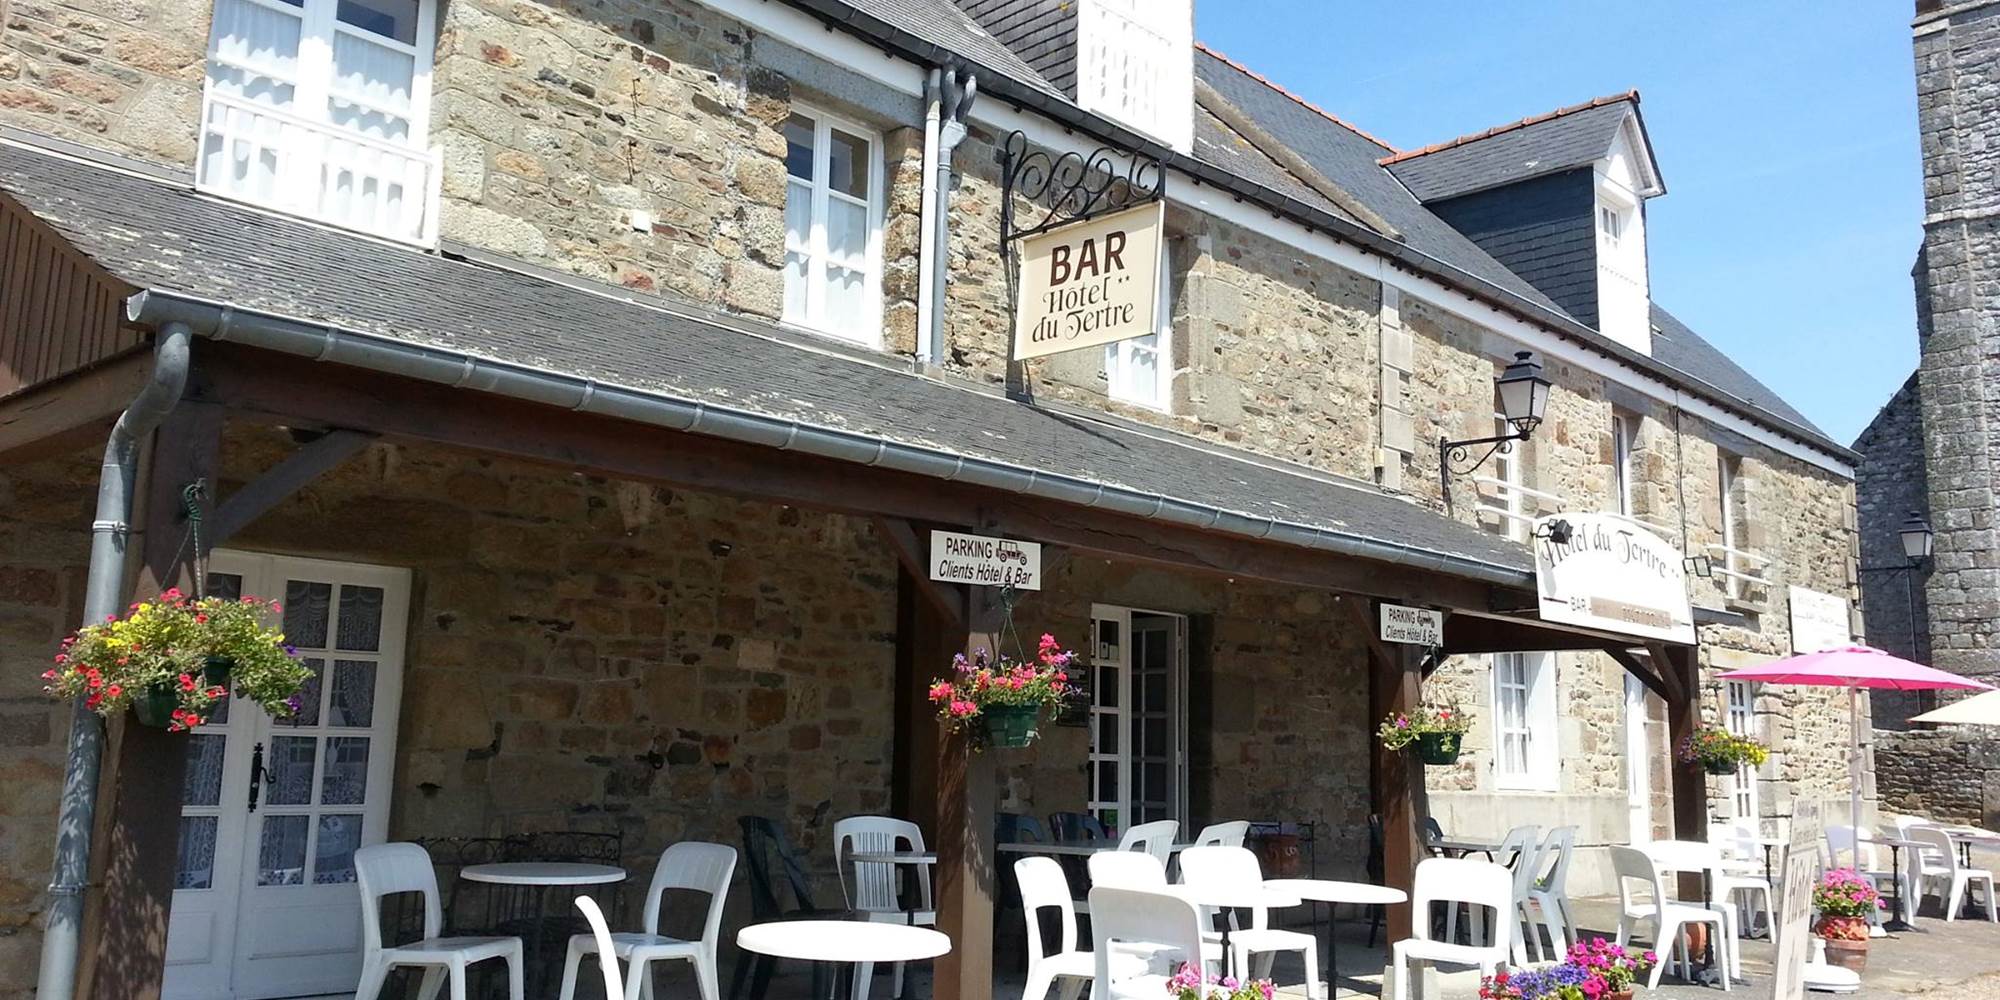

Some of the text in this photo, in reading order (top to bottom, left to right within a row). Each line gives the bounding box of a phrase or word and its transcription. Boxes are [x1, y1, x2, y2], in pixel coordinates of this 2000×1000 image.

[1050, 230, 1127, 287] BAR
[1043, 276, 1111, 314] Hôtel
[1032, 302, 1134, 343] du Tertre
[945, 537, 993, 559] PARKING
[1593, 523, 1612, 552] du
[1617, 529, 1667, 578] Tertre
[938, 559, 1033, 585] Clients Hôtel & Bar
[1388, 607, 1416, 624] PARKING
[1570, 596, 1587, 612] BAR
[1385, 624, 1406, 640] Clients
[1407, 627, 1422, 641] Hôtel
